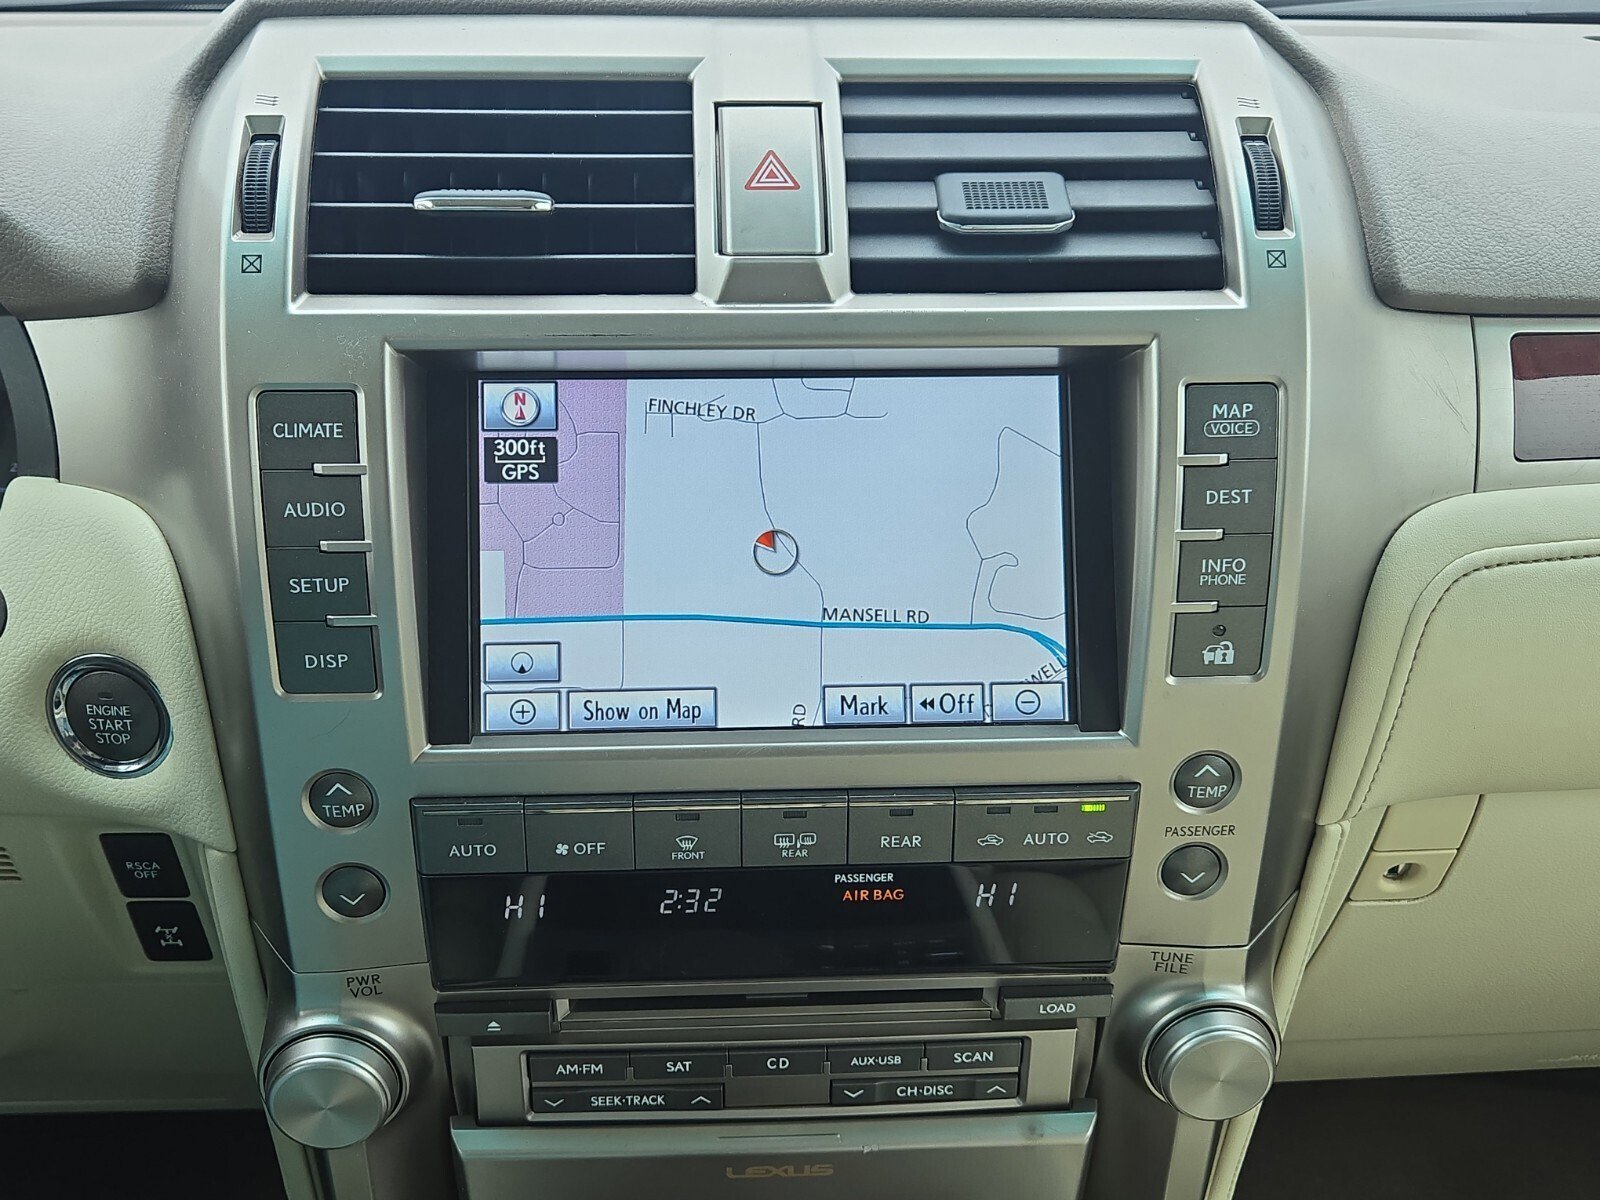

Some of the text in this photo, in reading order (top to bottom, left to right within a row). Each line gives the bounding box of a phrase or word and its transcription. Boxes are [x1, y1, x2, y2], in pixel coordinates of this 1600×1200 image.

[513, 392, 527, 406] N
[648, 398, 757, 421] FINCHLEY DR
[1212, 403, 1254, 419] MAP
[272, 422, 344, 439] CLIMATE
[1210, 422, 1254, 435] VOICE
[493, 438, 546, 457] 300ft
[501, 463, 540, 481] GPS
[1206, 489, 1253, 505] DEST
[283, 501, 346, 518] AUDIO
[1202, 558, 1247, 573] INFO
[289, 577, 350, 593] SETUP
[1200, 574, 1247, 586] PHONE
[822, 607, 930, 624] MANSELL RD
[304, 653, 349, 669] DISP
[86, 703, 131, 718] ENGINE
[583, 698, 702, 724] Show on Map
[840, 694, 889, 716] Mark
[938, 692, 975, 714] Off
[89, 717, 133, 731] START
[95, 731, 131, 745] STOP
[1187, 784, 1228, 799] TEMP
[322, 803, 365, 818] TEMP
[1164, 824, 1236, 837] PASSENGER
[880, 835, 922, 848] REAR
[1023, 832, 1069, 845] AUTO
[449, 844, 496, 857] AUTO
[573, 842, 606, 855] OFF
[781, 849, 808, 858] REAR
[671, 851, 705, 861] FRONT
[126, 862, 160, 870] RSCA
[134, 871, 158, 879] OFF
[834, 872, 894, 884] PASSENGER
[659, 888, 722, 914] 2:32
[843, 888, 905, 901] AIR BAG
[1151, 951, 1194, 964] TUNE
[1154, 963, 1188, 974] FILE
[346, 974, 382, 988] PWR
[349, 986, 383, 998] VOL
[1039, 1003, 1076, 1014] LOAD
[766, 1058, 789, 1069] CD
[953, 1051, 994, 1063] SCAN
[666, 1061, 692, 1073] SAT
[726, 1164, 834, 1179] LEXUS
